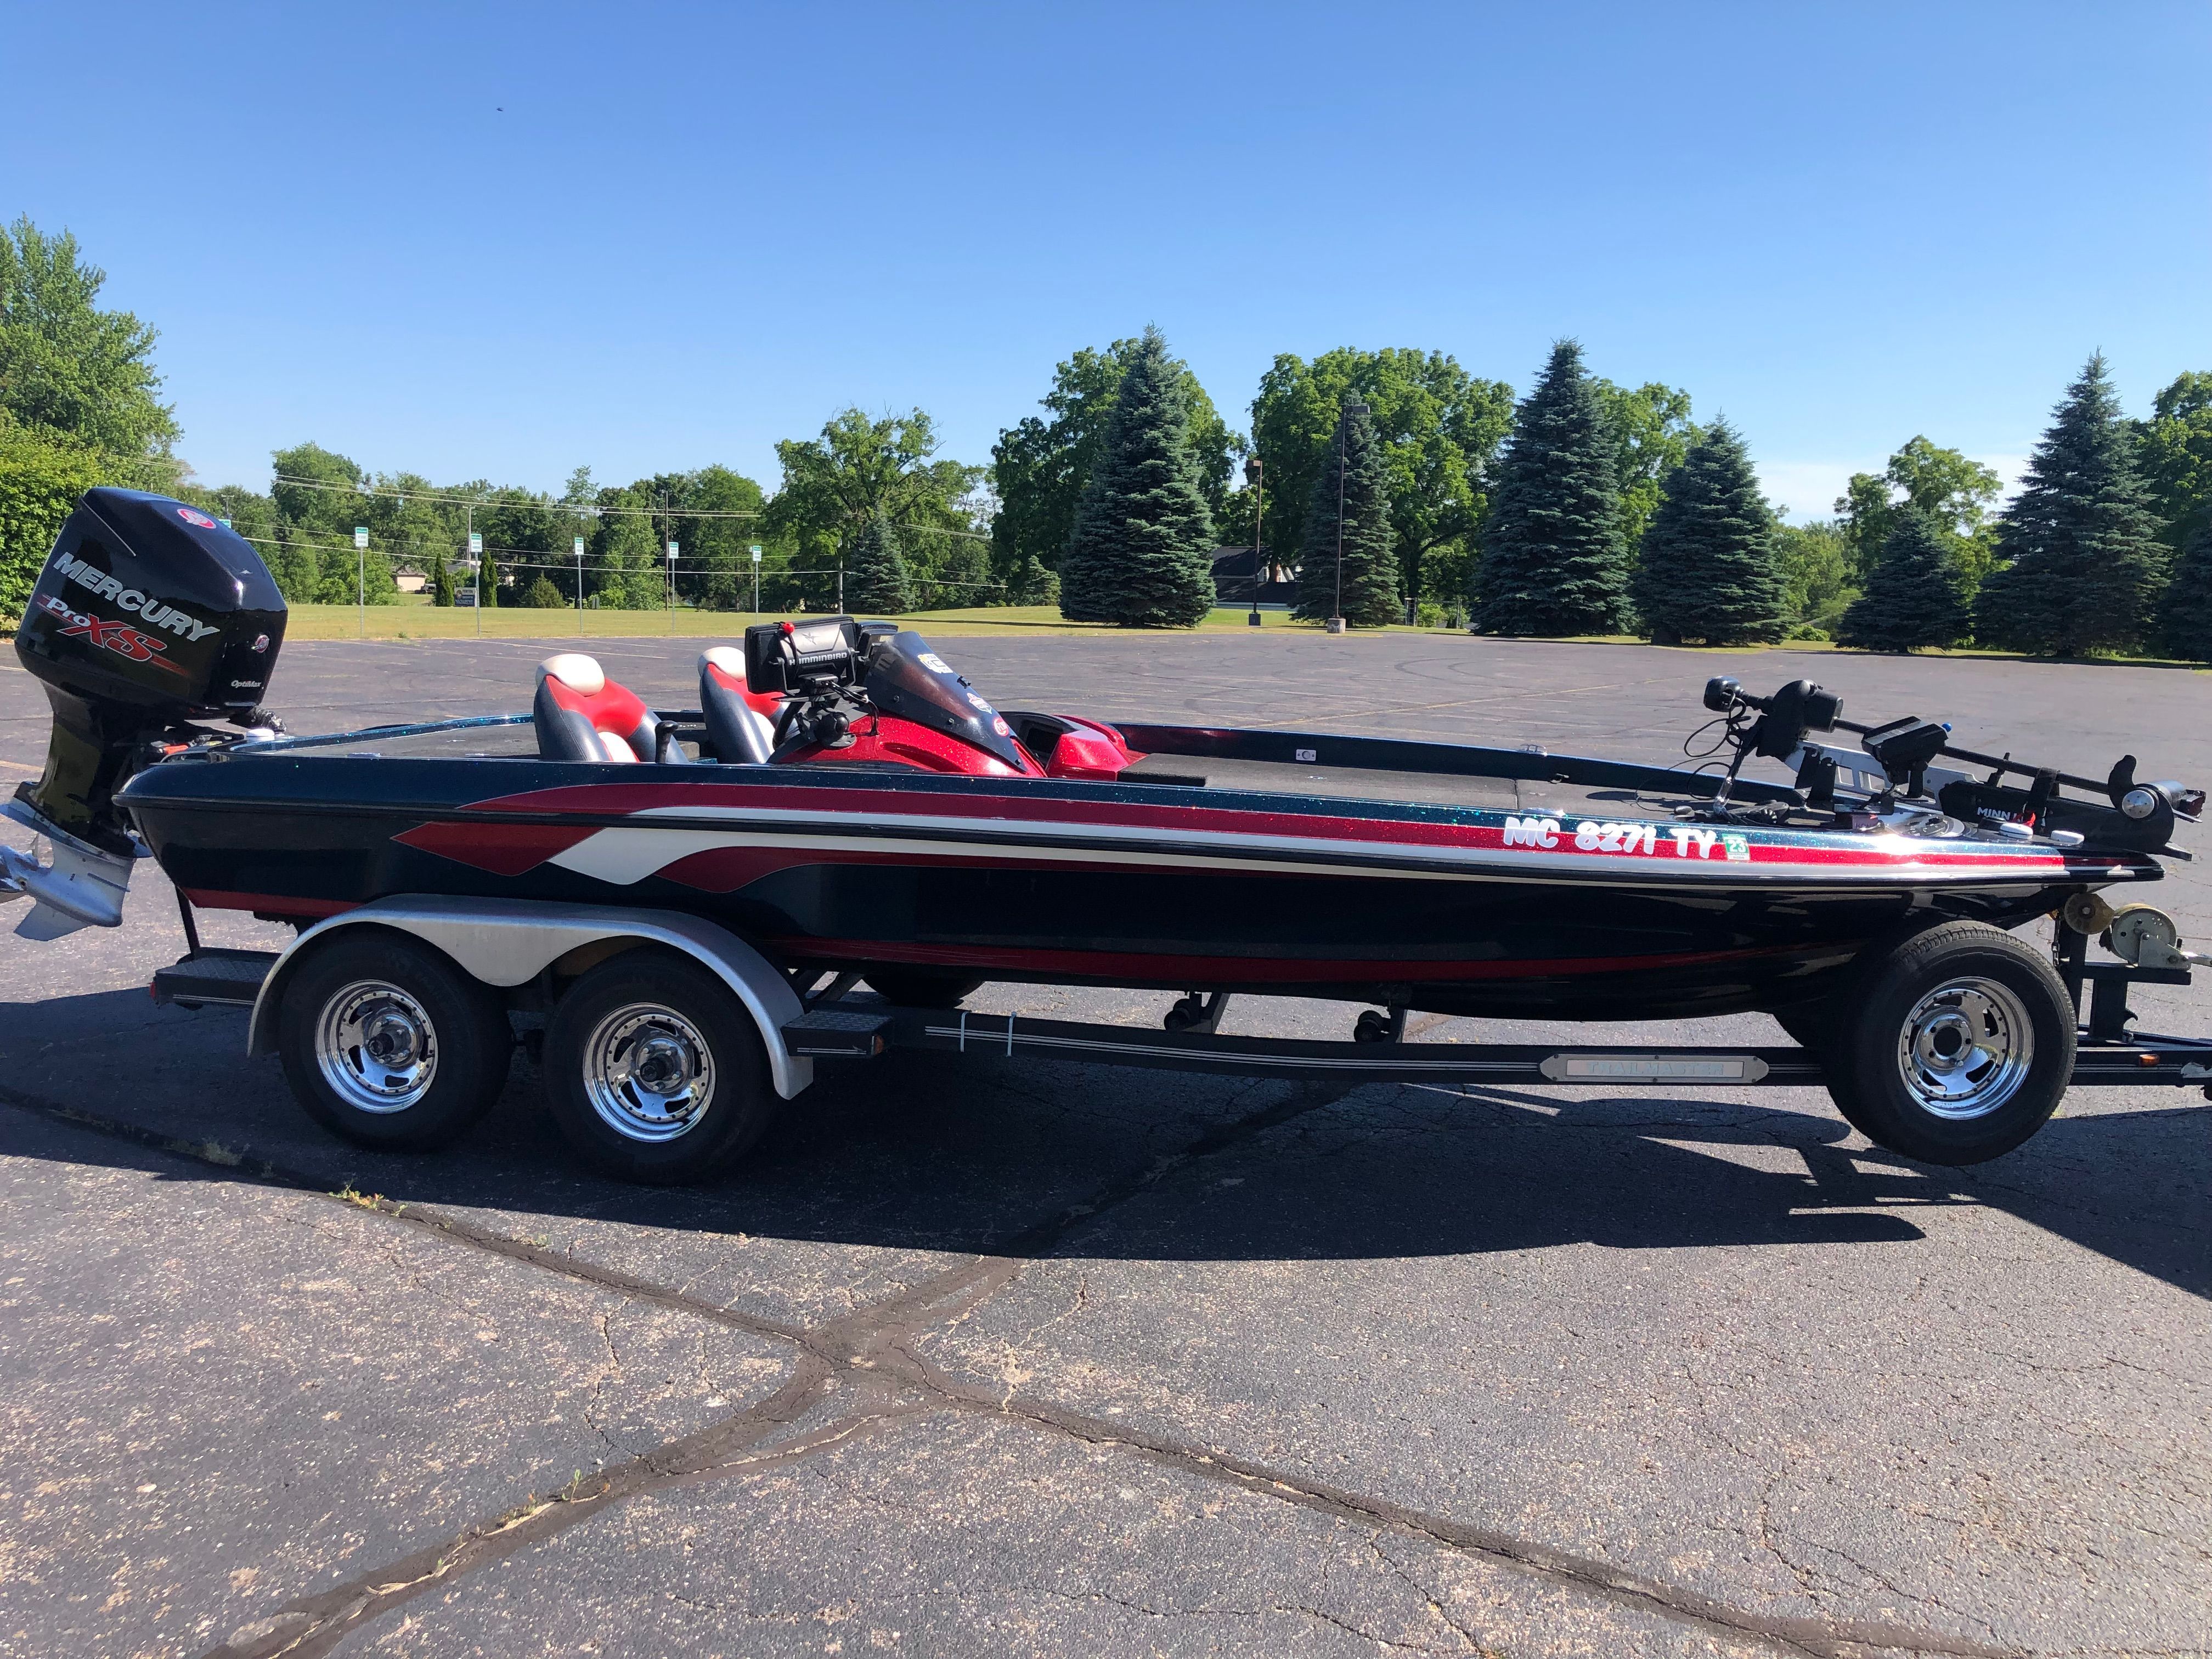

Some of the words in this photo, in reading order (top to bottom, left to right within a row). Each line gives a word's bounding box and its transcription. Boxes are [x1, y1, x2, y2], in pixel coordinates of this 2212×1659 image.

[53, 552, 220, 641] MERCURY
[1977, 807, 2011, 820] MINN
[1503, 816, 1561, 848] MC
[1575, 821, 1657, 855] 8271
[1669, 828, 1717, 859] TY
[1727, 839, 1746, 853] 23
